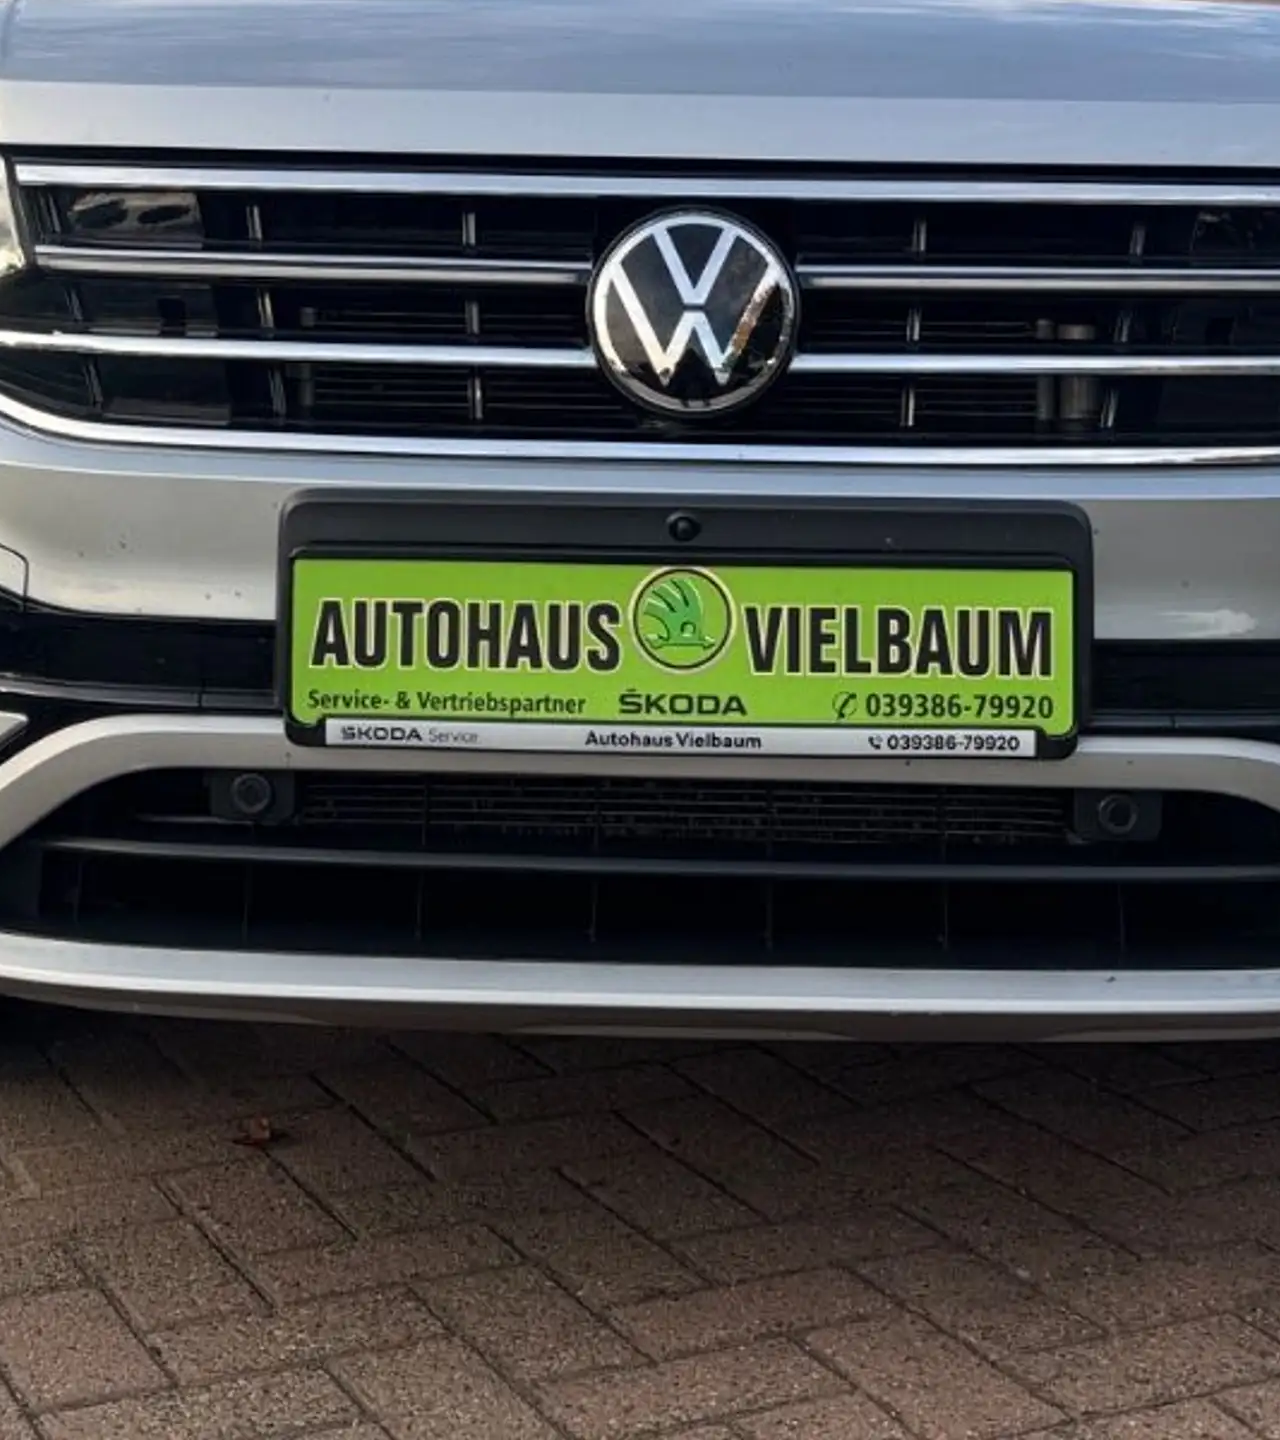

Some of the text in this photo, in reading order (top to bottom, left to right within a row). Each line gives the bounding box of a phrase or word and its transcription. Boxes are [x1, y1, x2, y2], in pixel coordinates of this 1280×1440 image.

[309, 597, 1054, 679] AUTOHAUS VIELBAUM
[307, 689, 587, 717] Service- & Vertriebspartner
[619, 688, 748, 717] ŠKODA
[865, 693, 1055, 720] 039386-79920
[428, 727, 479, 744] Service
[584, 730, 763, 749] Autohaus Vielbaum
[887, 734, 1021, 751] 039386-79920
